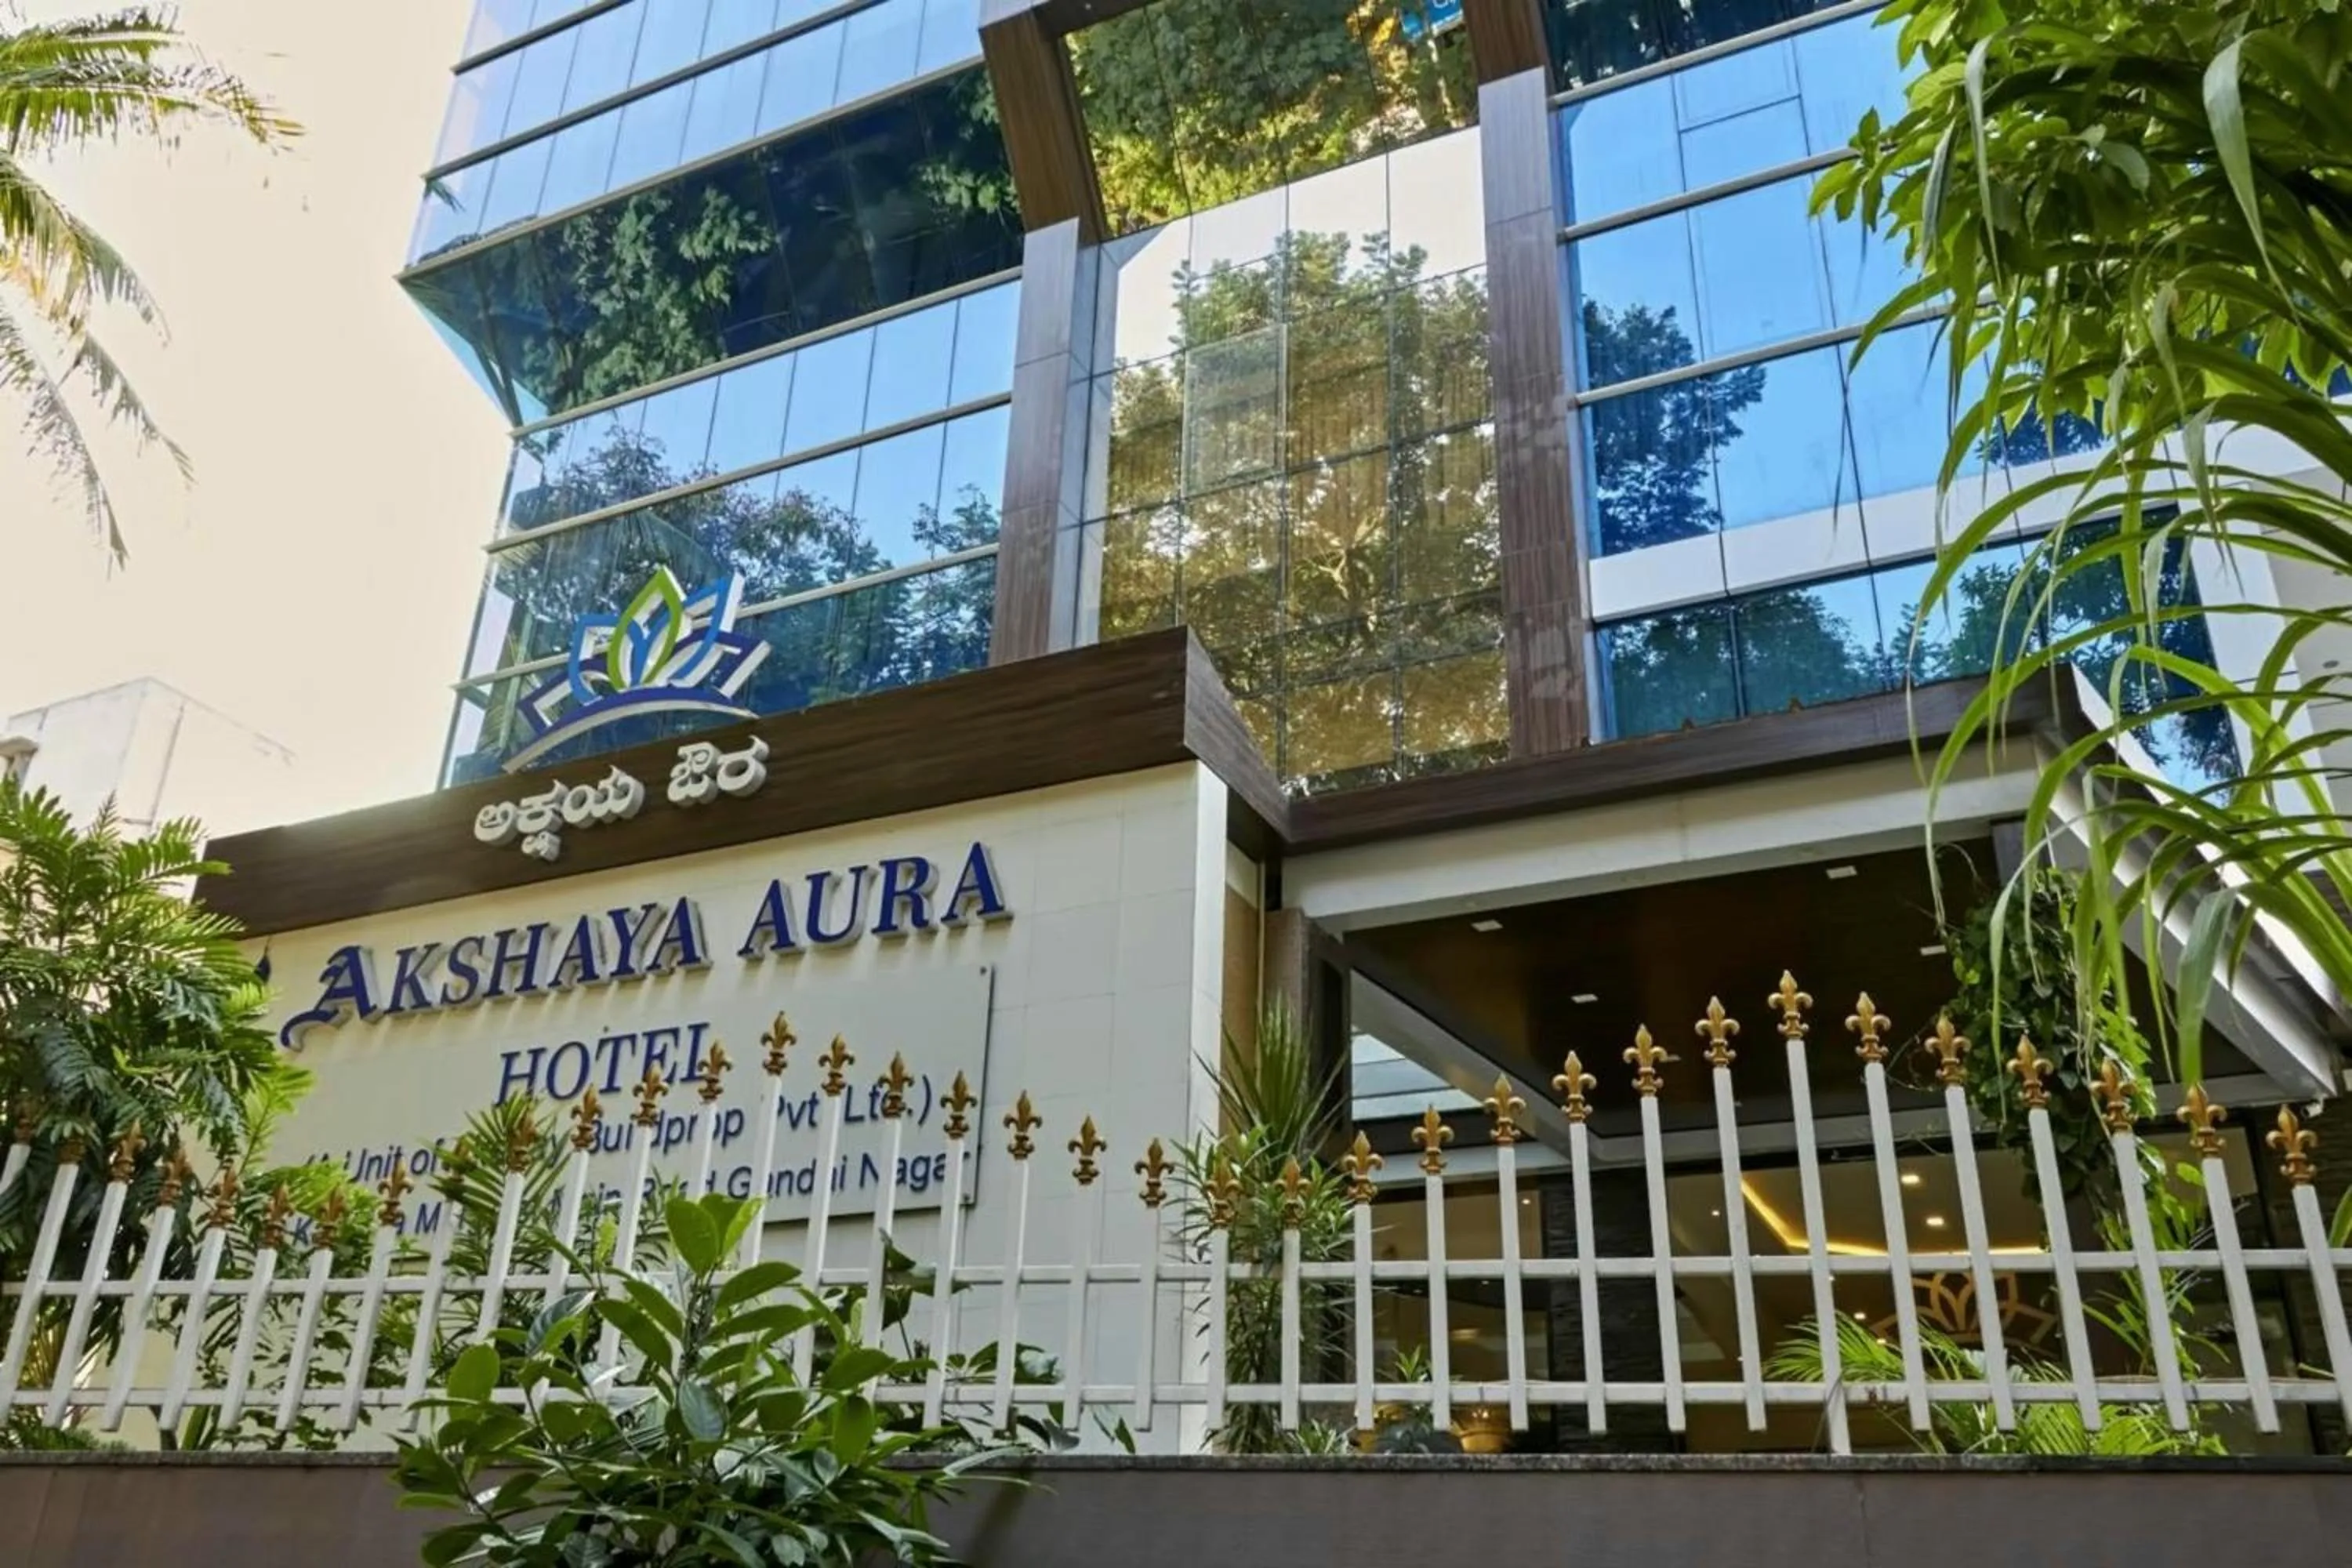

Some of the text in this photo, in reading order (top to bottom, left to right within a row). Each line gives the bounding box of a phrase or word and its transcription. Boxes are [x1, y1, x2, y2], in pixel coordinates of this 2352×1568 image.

[280, 840, 1008, 1049] AKSHAYA AURA
[494, 1020, 711, 1107] HOTEL
